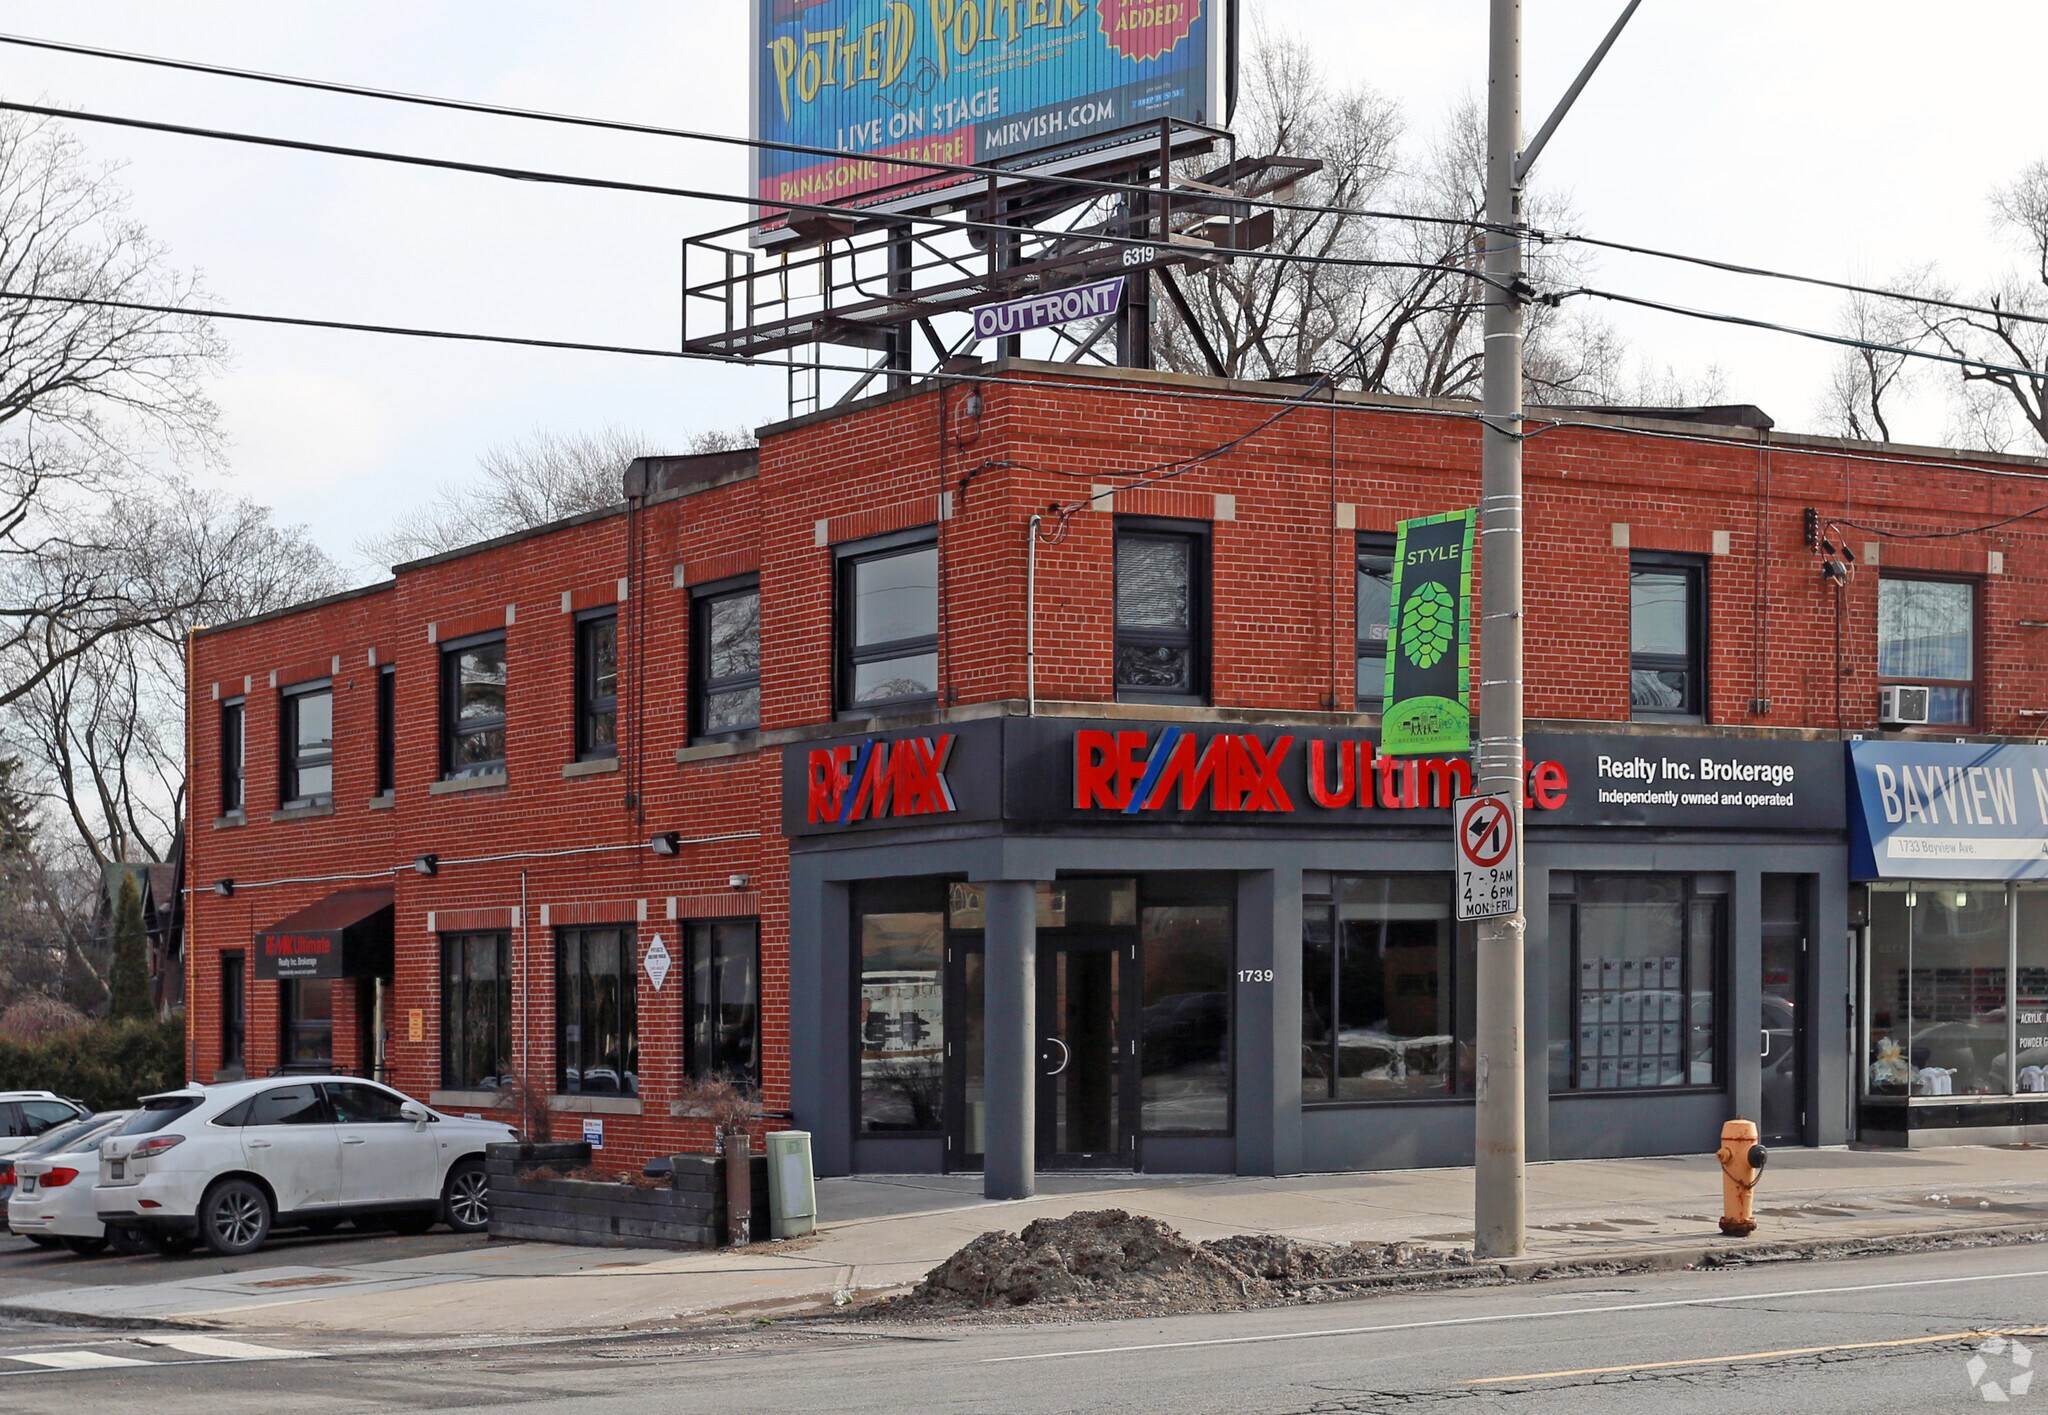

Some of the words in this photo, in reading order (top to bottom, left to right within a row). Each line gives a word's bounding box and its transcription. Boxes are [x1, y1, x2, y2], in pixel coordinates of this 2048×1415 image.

[1115, 2, 1184, 32] ADDED!
[766, 2, 916, 126] POTTED
[838, 118, 882, 151] LIVE
[889, 107, 924, 139] ON
[933, 87, 999, 131] STAGE
[985, 98, 1115, 150] MIRVISH.COM
[780, 159, 879, 202] PANASONIC
[886, 135, 965, 176] THEATRE
[1122, 246, 1155, 266] 6319
[978, 284, 1116, 336] OUTFRONT
[1407, 543, 1460, 566] STYLE
[807, 734, 957, 825] RE/MAX
[1073, 726, 1296, 814] RE/MAX
[1306, 739, 1569, 811] Ultime
[1597, 755, 1657, 784] Realty
[1661, 757, 1696, 781] Inc.
[1699, 758, 1795, 786] Brokerage
[1598, 788, 1679, 807] Independently
[1680, 791, 1719, 806] owned
[1720, 792, 1743, 806] and
[1744, 792, 1794, 809] operated
[1875, 764, 2018, 825] BAYVIEW
[1898, 839, 1921, 853] 1733
[1921, 840, 1957, 856] Bayview
[1958, 841, 1977, 855] Ave.
[1463, 872, 1472, 886] 7
[1464, 888, 1472, 902] 4
[1237, 969, 1274, 983] 1739
[2019, 1037, 2043, 1048] POWDER
